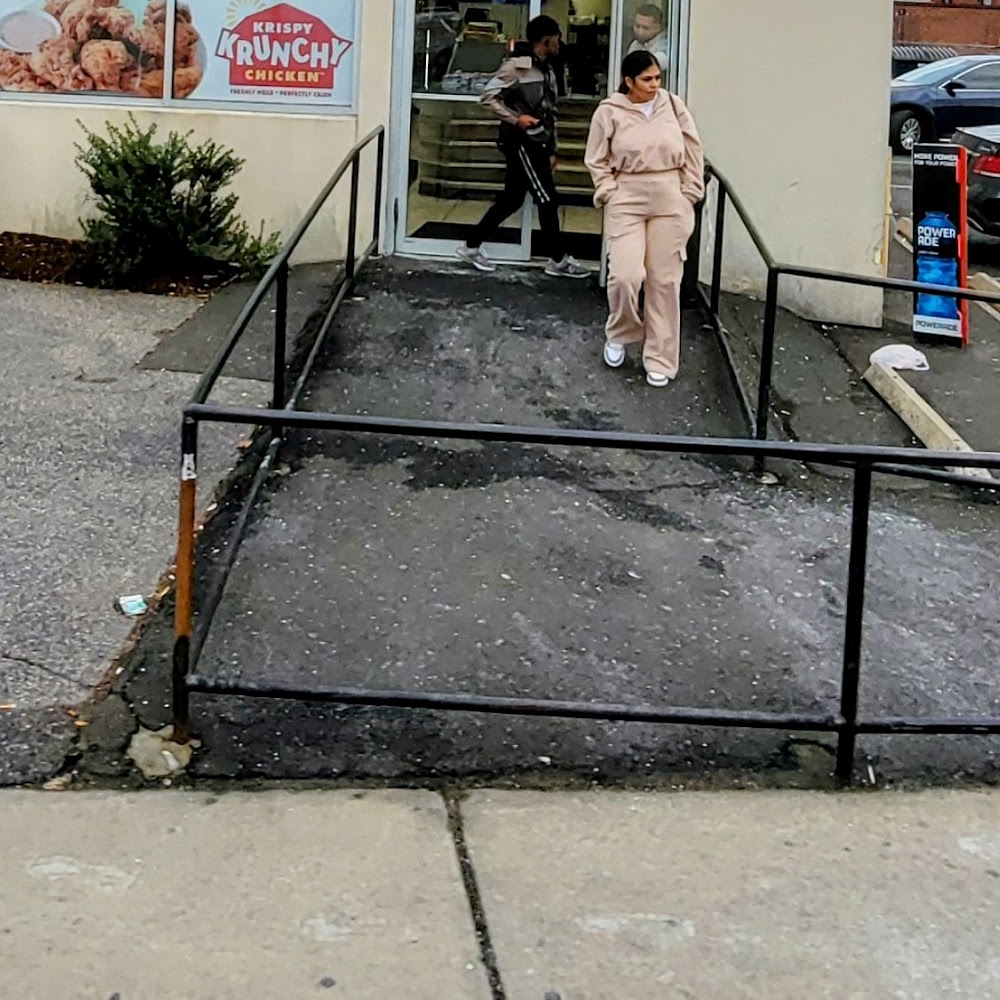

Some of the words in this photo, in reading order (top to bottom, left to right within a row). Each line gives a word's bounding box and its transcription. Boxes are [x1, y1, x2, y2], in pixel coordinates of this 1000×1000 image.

[253, 22, 313, 34] KRISPY
[217, 30, 348, 68] KRUNCHY
[244, 69, 319, 82] CHICKEN
[917, 226, 956, 239] POWER
[917, 236, 939, 247] ADE
[915, 319, 958, 332] POWERADE
